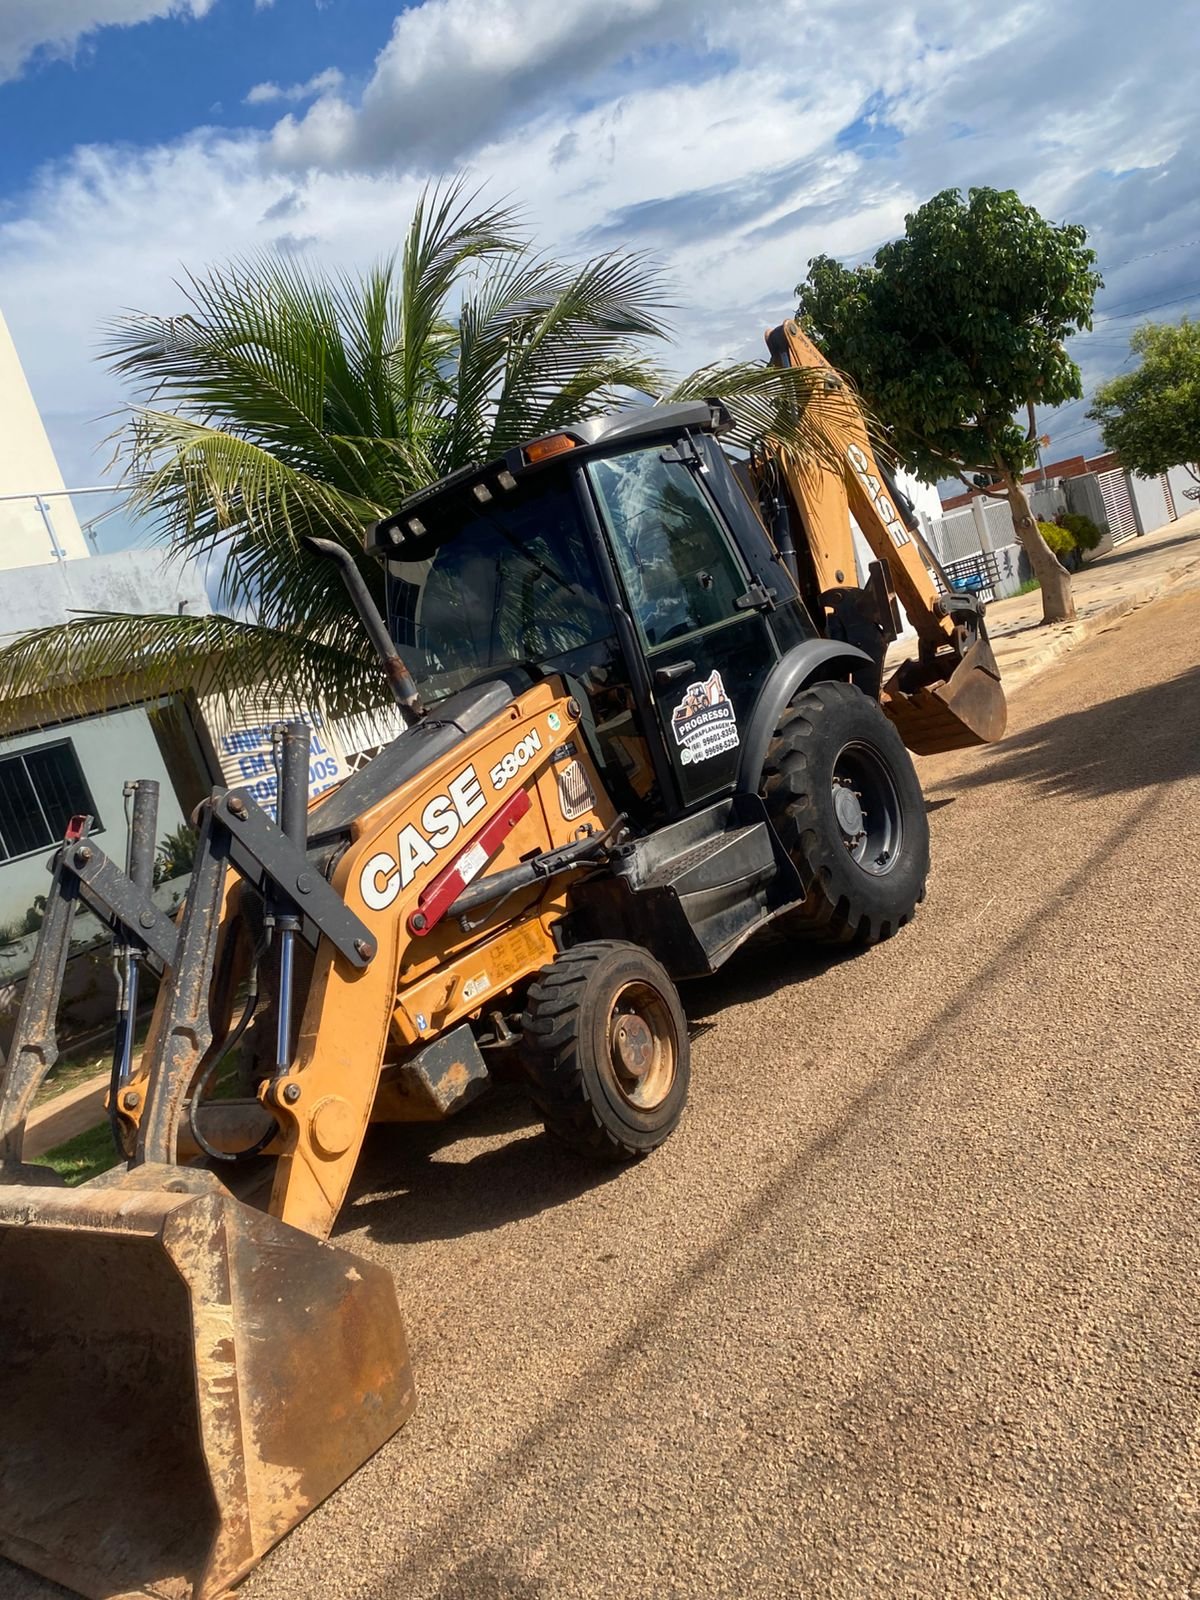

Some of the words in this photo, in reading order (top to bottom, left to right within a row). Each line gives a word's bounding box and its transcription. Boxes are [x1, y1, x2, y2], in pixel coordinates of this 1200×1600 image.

[847, 442, 910, 548] CASE
[678, 708, 730, 736] PROGRESSO
[684, 721, 730, 744] TERRAPLANAGEM
[239, 753, 268, 779] EM
[488, 728, 543, 790] 580N
[359, 763, 488, 911] CASE
